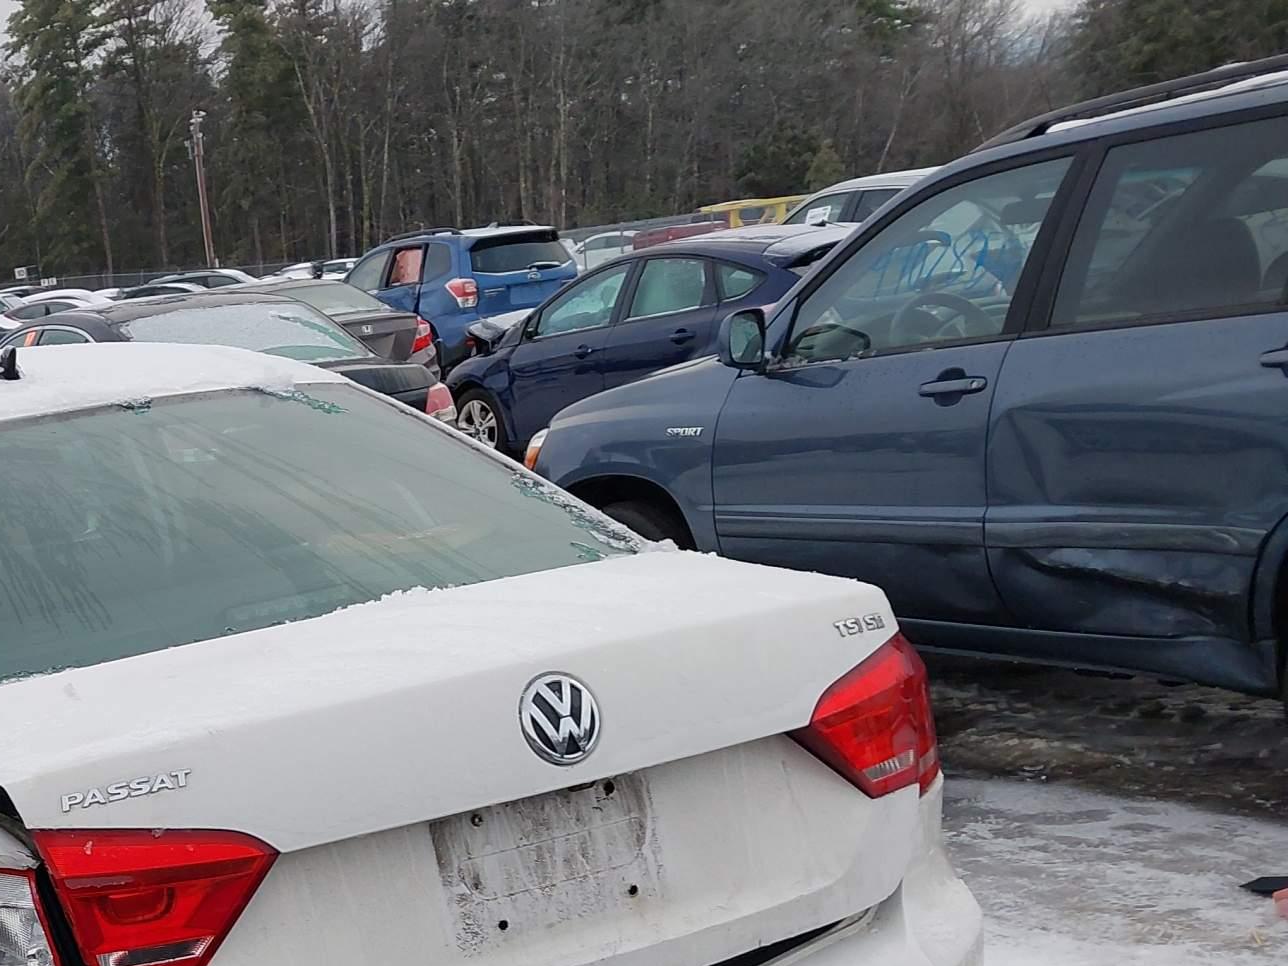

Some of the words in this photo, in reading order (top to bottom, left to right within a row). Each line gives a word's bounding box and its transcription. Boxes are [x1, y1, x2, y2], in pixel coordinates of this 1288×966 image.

[665, 427, 704, 437] SPORT
[833, 617, 863, 637] TSI
[61, 769, 191, 813] PASSAT
